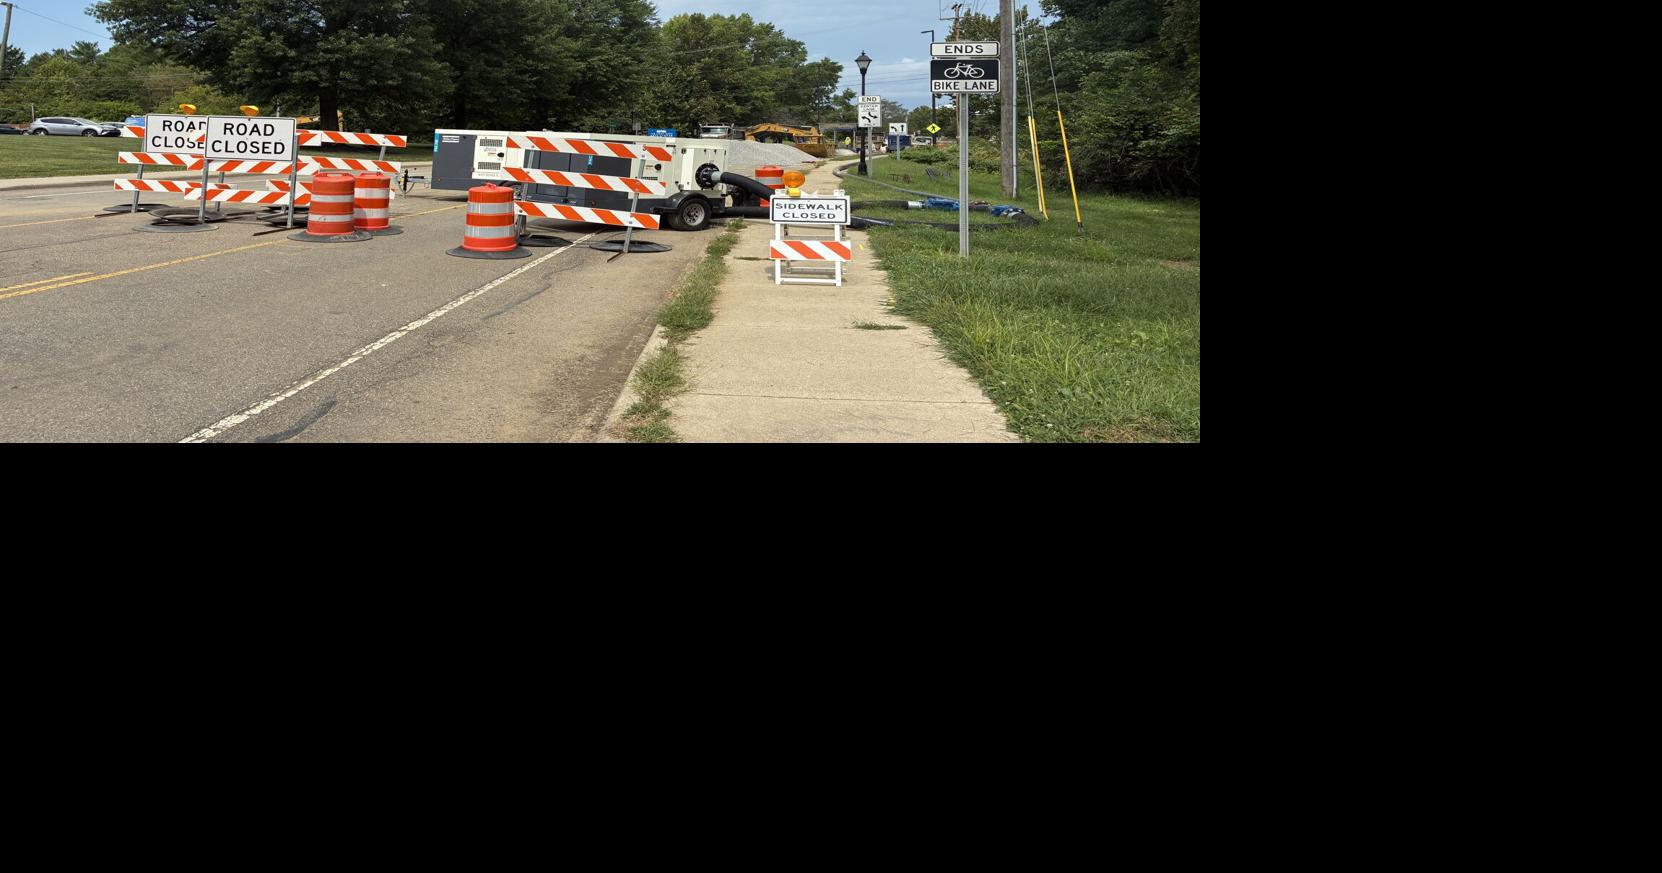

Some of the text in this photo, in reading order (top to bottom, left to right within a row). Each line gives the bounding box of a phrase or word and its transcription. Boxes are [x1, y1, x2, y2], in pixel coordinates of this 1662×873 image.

[945, 45, 984, 54] ENDS
[934, 82, 995, 90] BIKE LANE
[223, 123, 275, 136] ROAD
[152, 136, 205, 149] CLOSE
[211, 140, 286, 154] CLOSED
